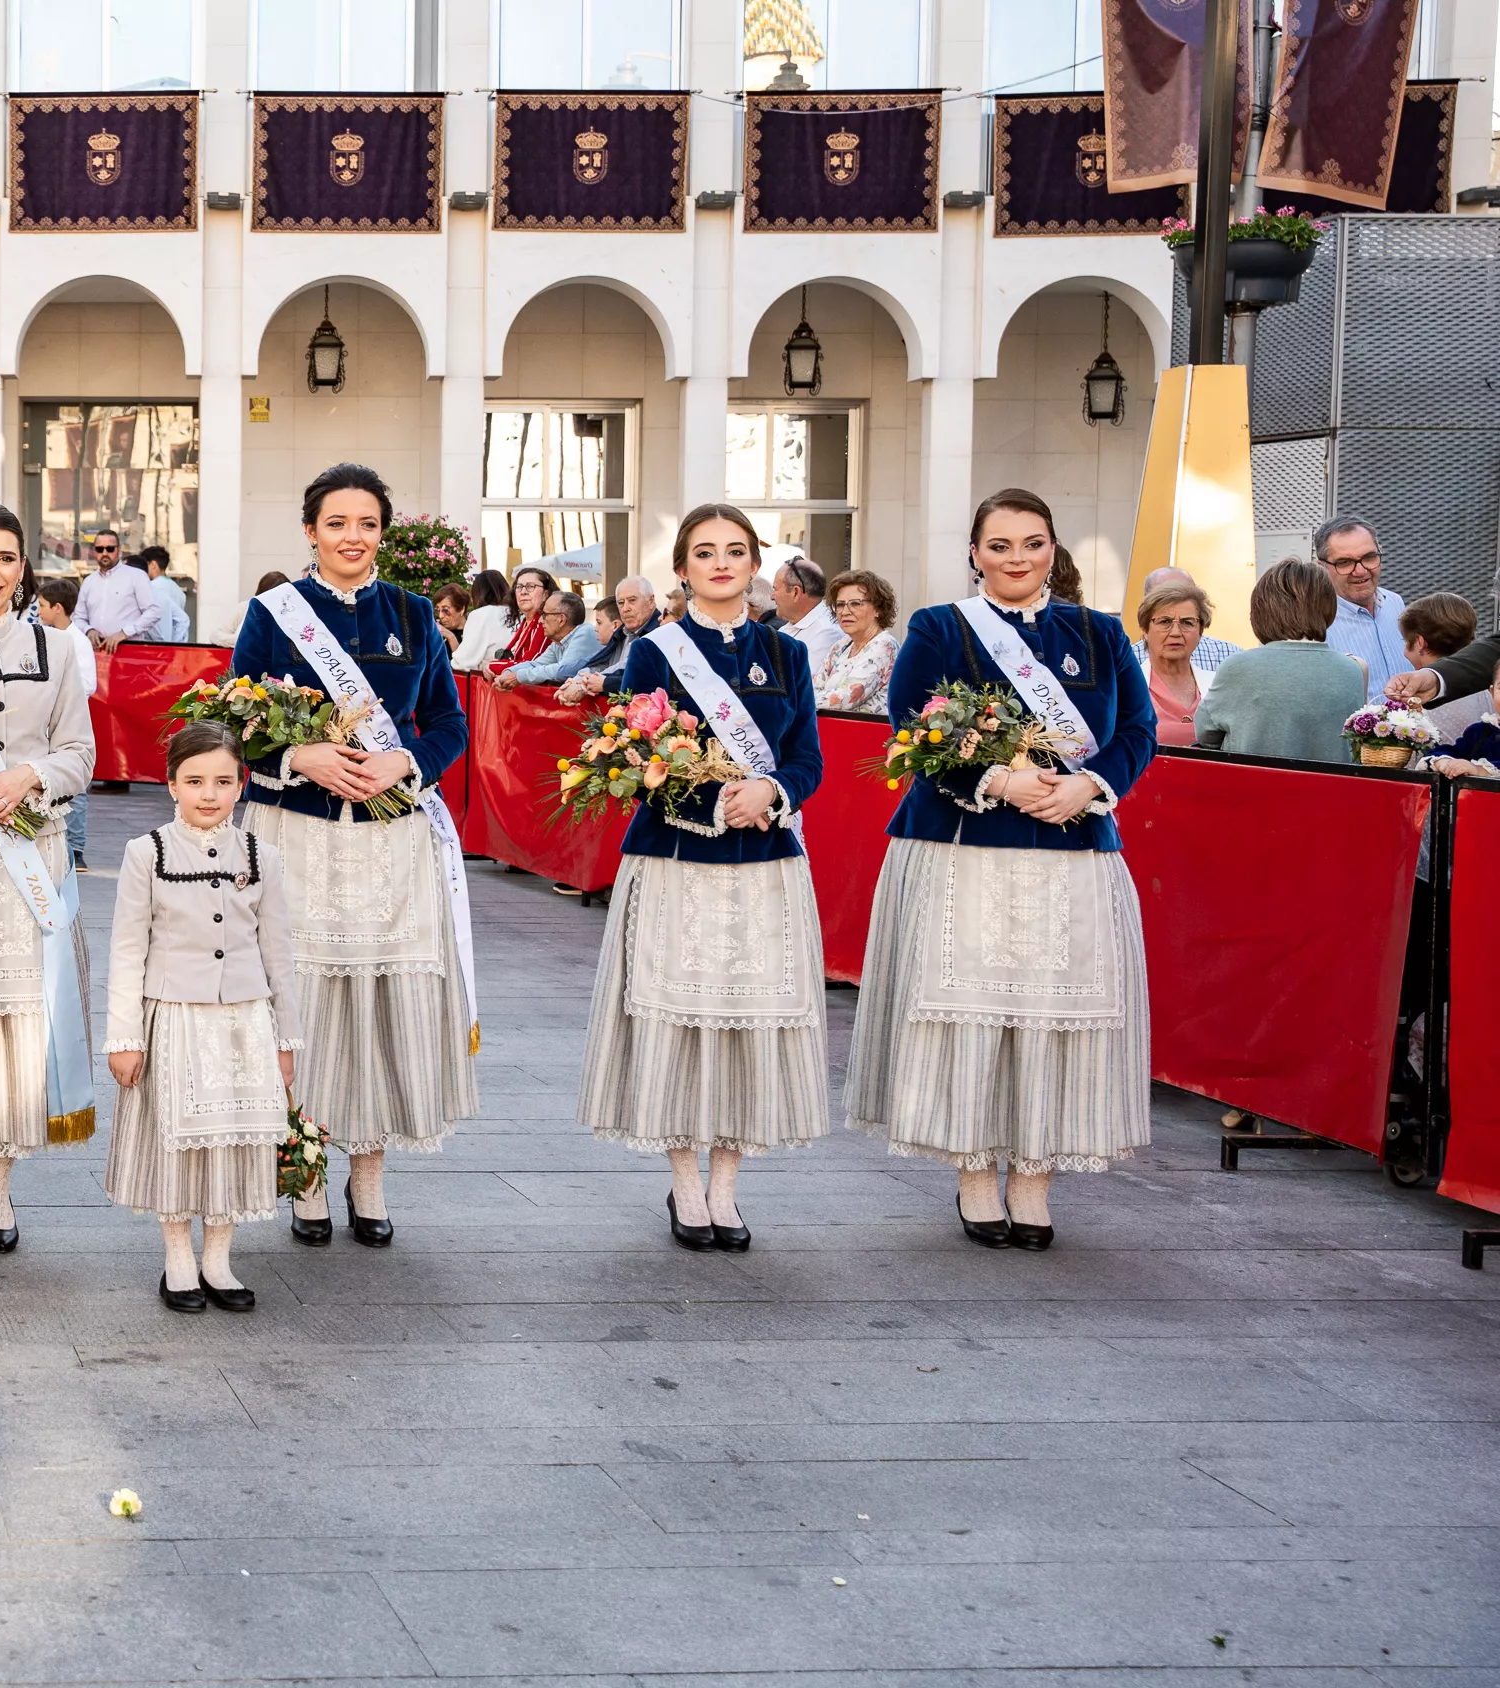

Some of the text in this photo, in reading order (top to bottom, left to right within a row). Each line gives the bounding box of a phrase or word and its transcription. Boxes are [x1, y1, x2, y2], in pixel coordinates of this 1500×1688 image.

[315, 647, 360, 696] DAMA
[1032, 683, 1077, 736] DAMA
[730, 728, 768, 775] DAMA
